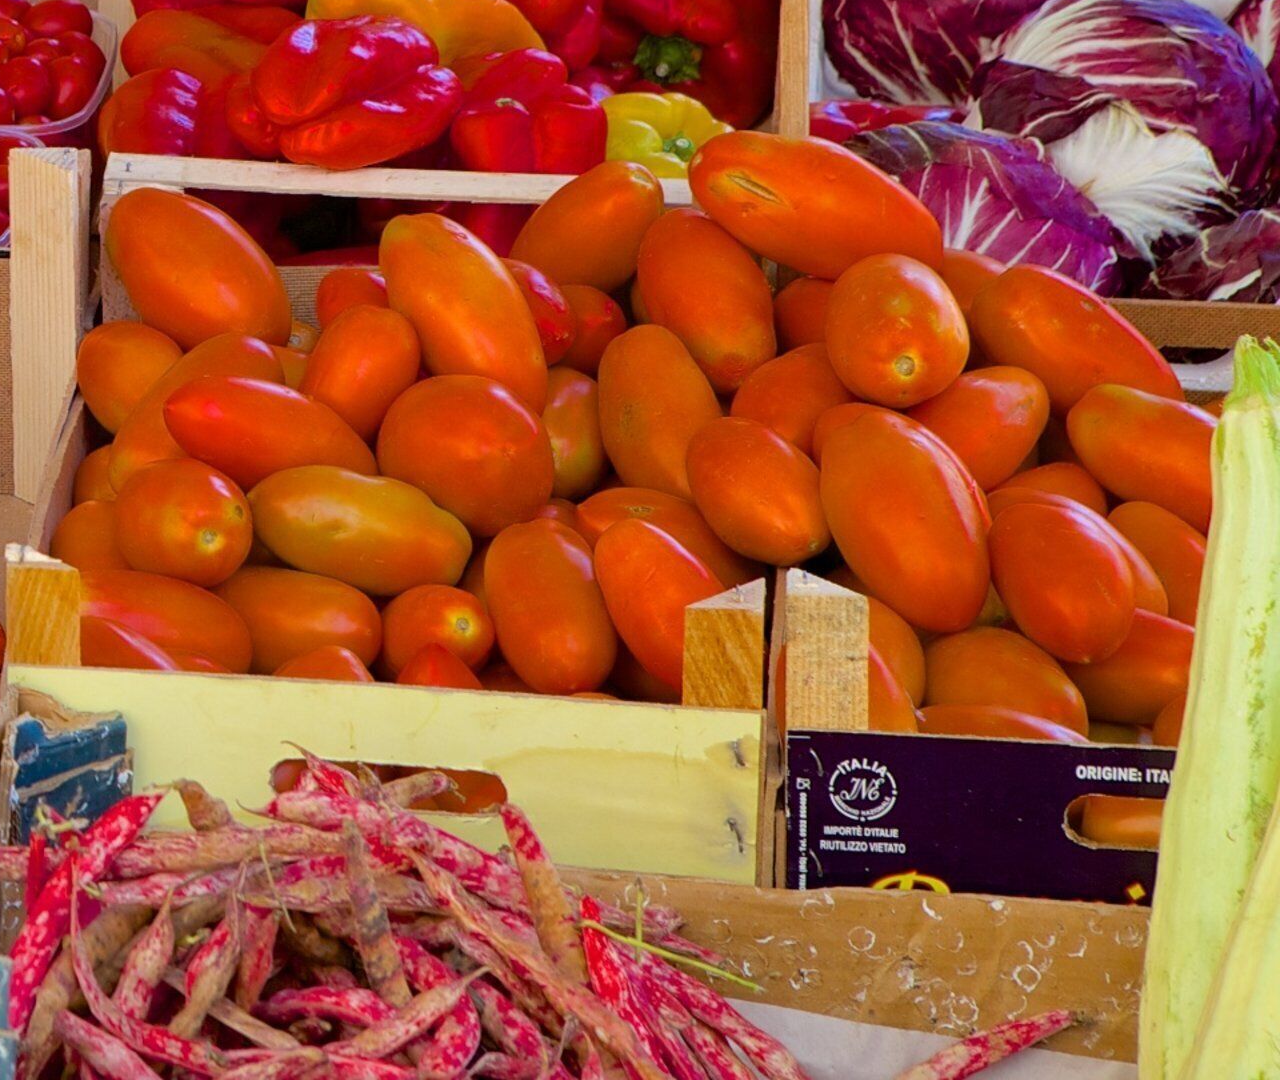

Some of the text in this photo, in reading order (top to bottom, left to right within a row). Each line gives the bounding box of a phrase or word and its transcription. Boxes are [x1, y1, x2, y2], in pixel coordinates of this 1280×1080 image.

[837, 757, 888, 778] ITALIA
[1075, 763, 1143, 783] ORIGINE:
[819, 839, 906, 855] RIUTILIZZO VIETATO
